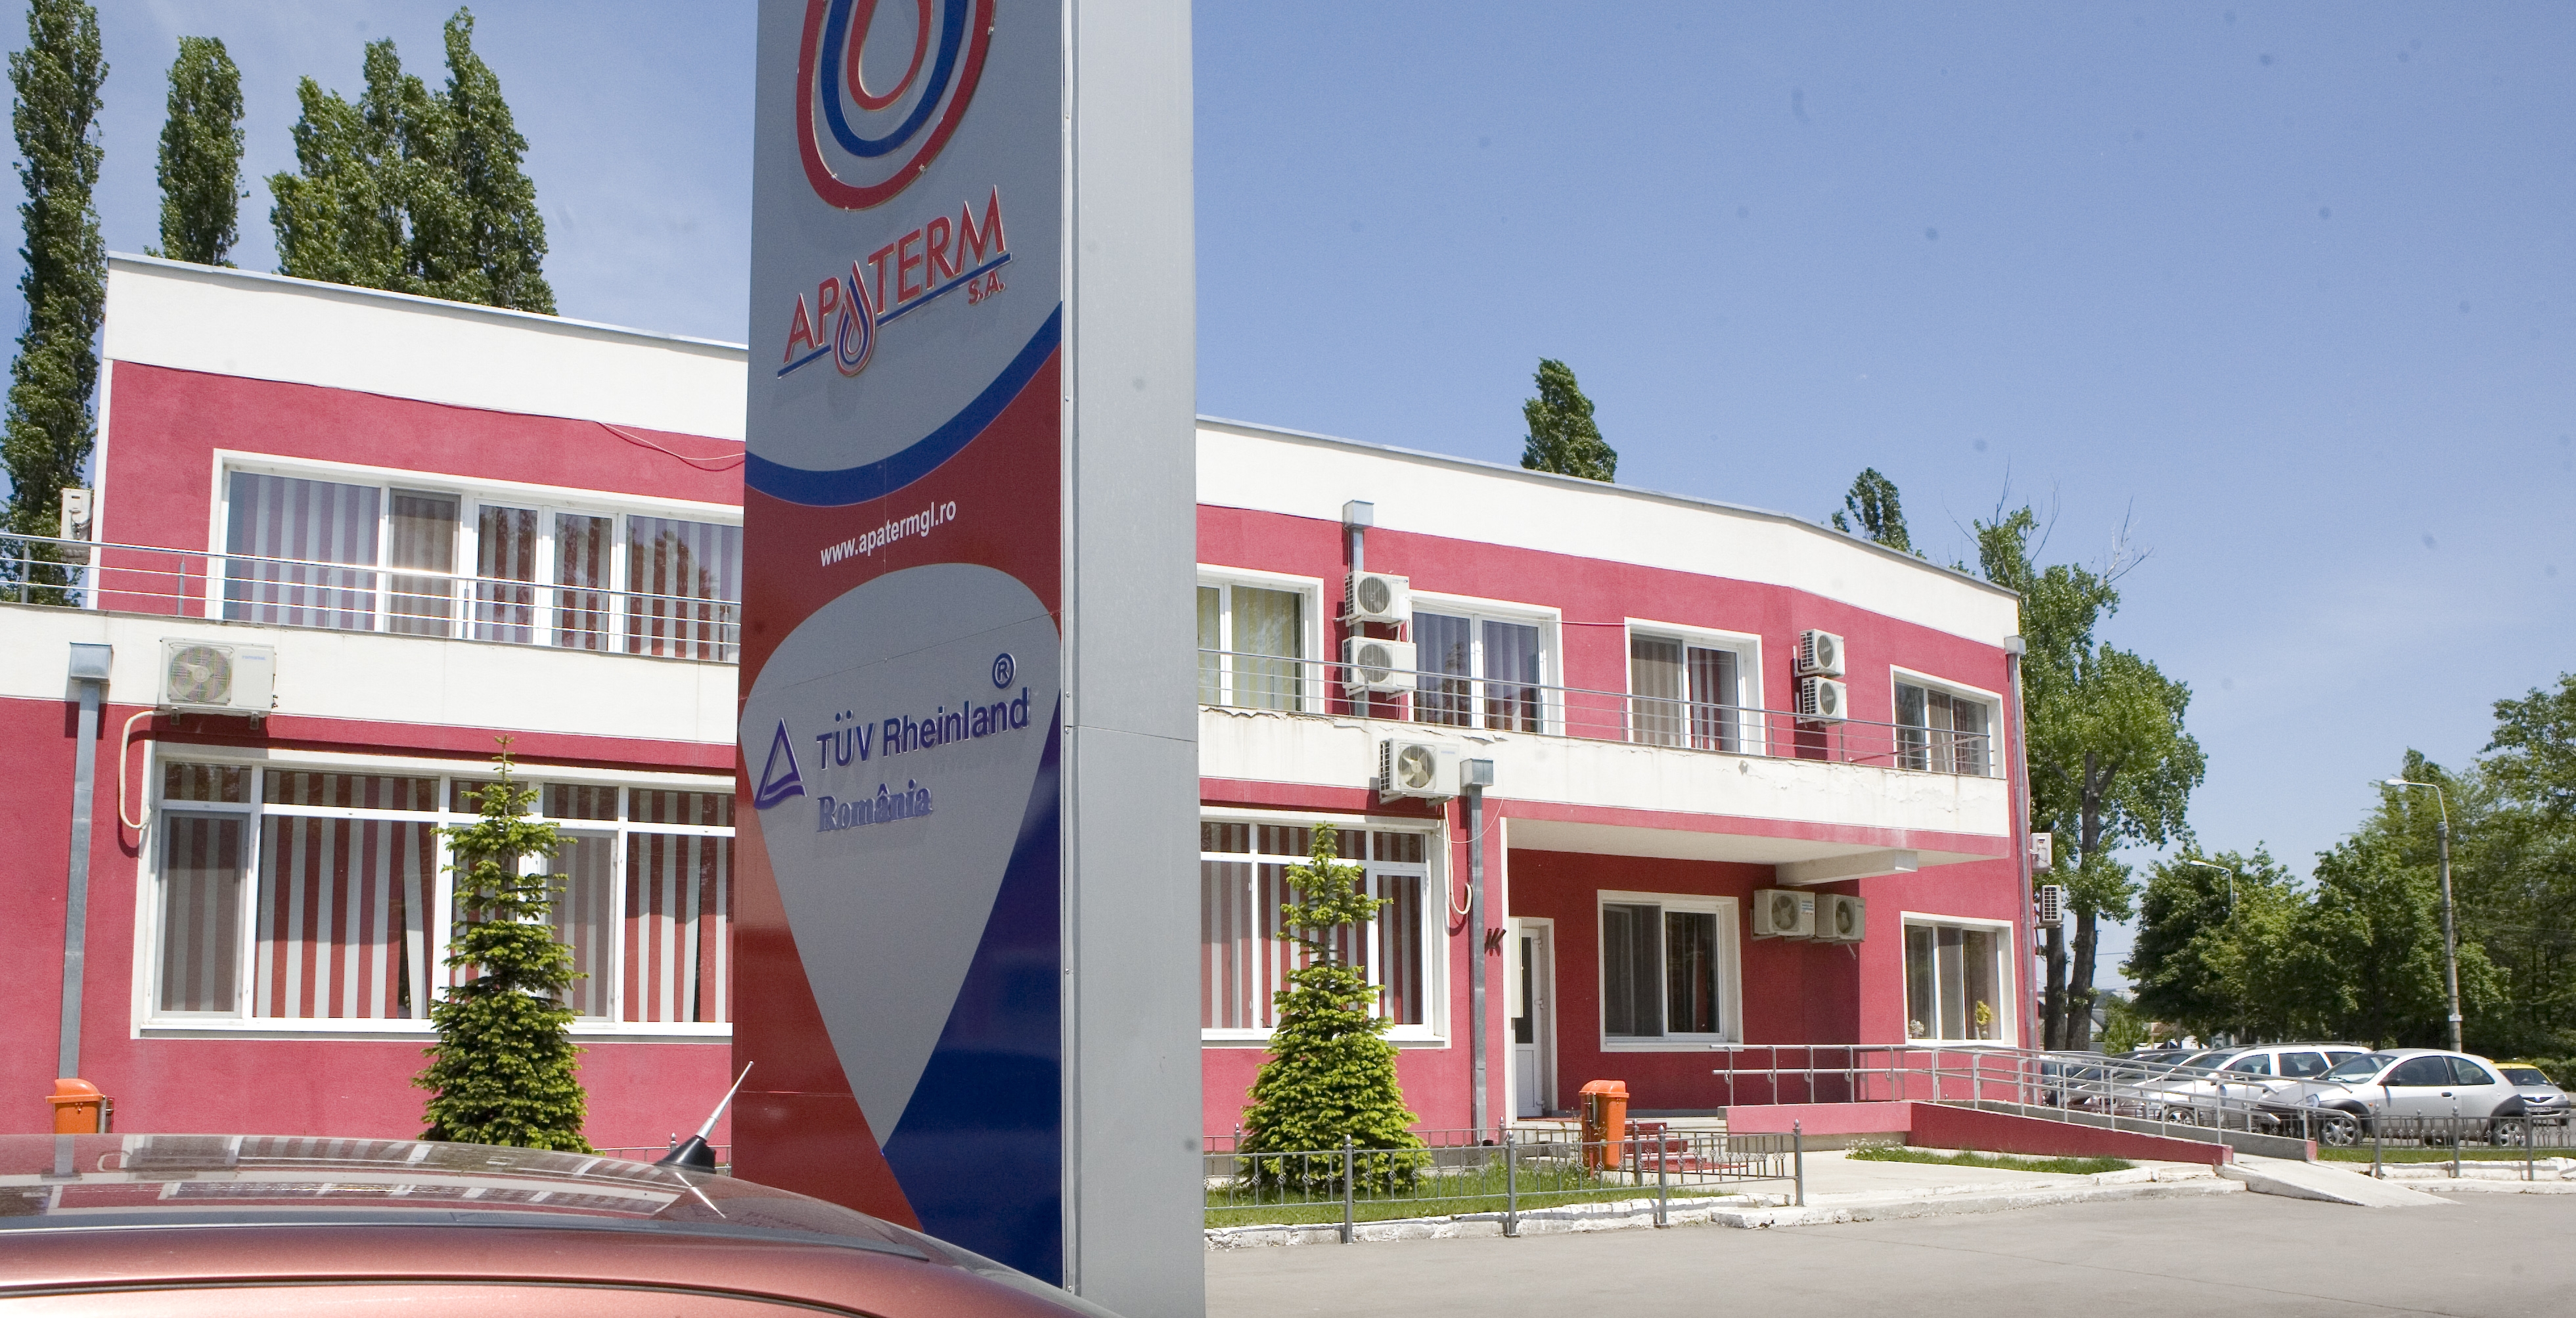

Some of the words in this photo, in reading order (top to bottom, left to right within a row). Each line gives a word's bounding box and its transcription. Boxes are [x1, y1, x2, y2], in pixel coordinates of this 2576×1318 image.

[784, 185, 1006, 376] APATERM
[968, 270, 1005, 305] S.A.
[820, 501, 957, 567] www.apatermgl.ro
[817, 710, 874, 770] TÜV
[883, 687, 1030, 757] Rheinland
[817, 779, 933, 833] România
